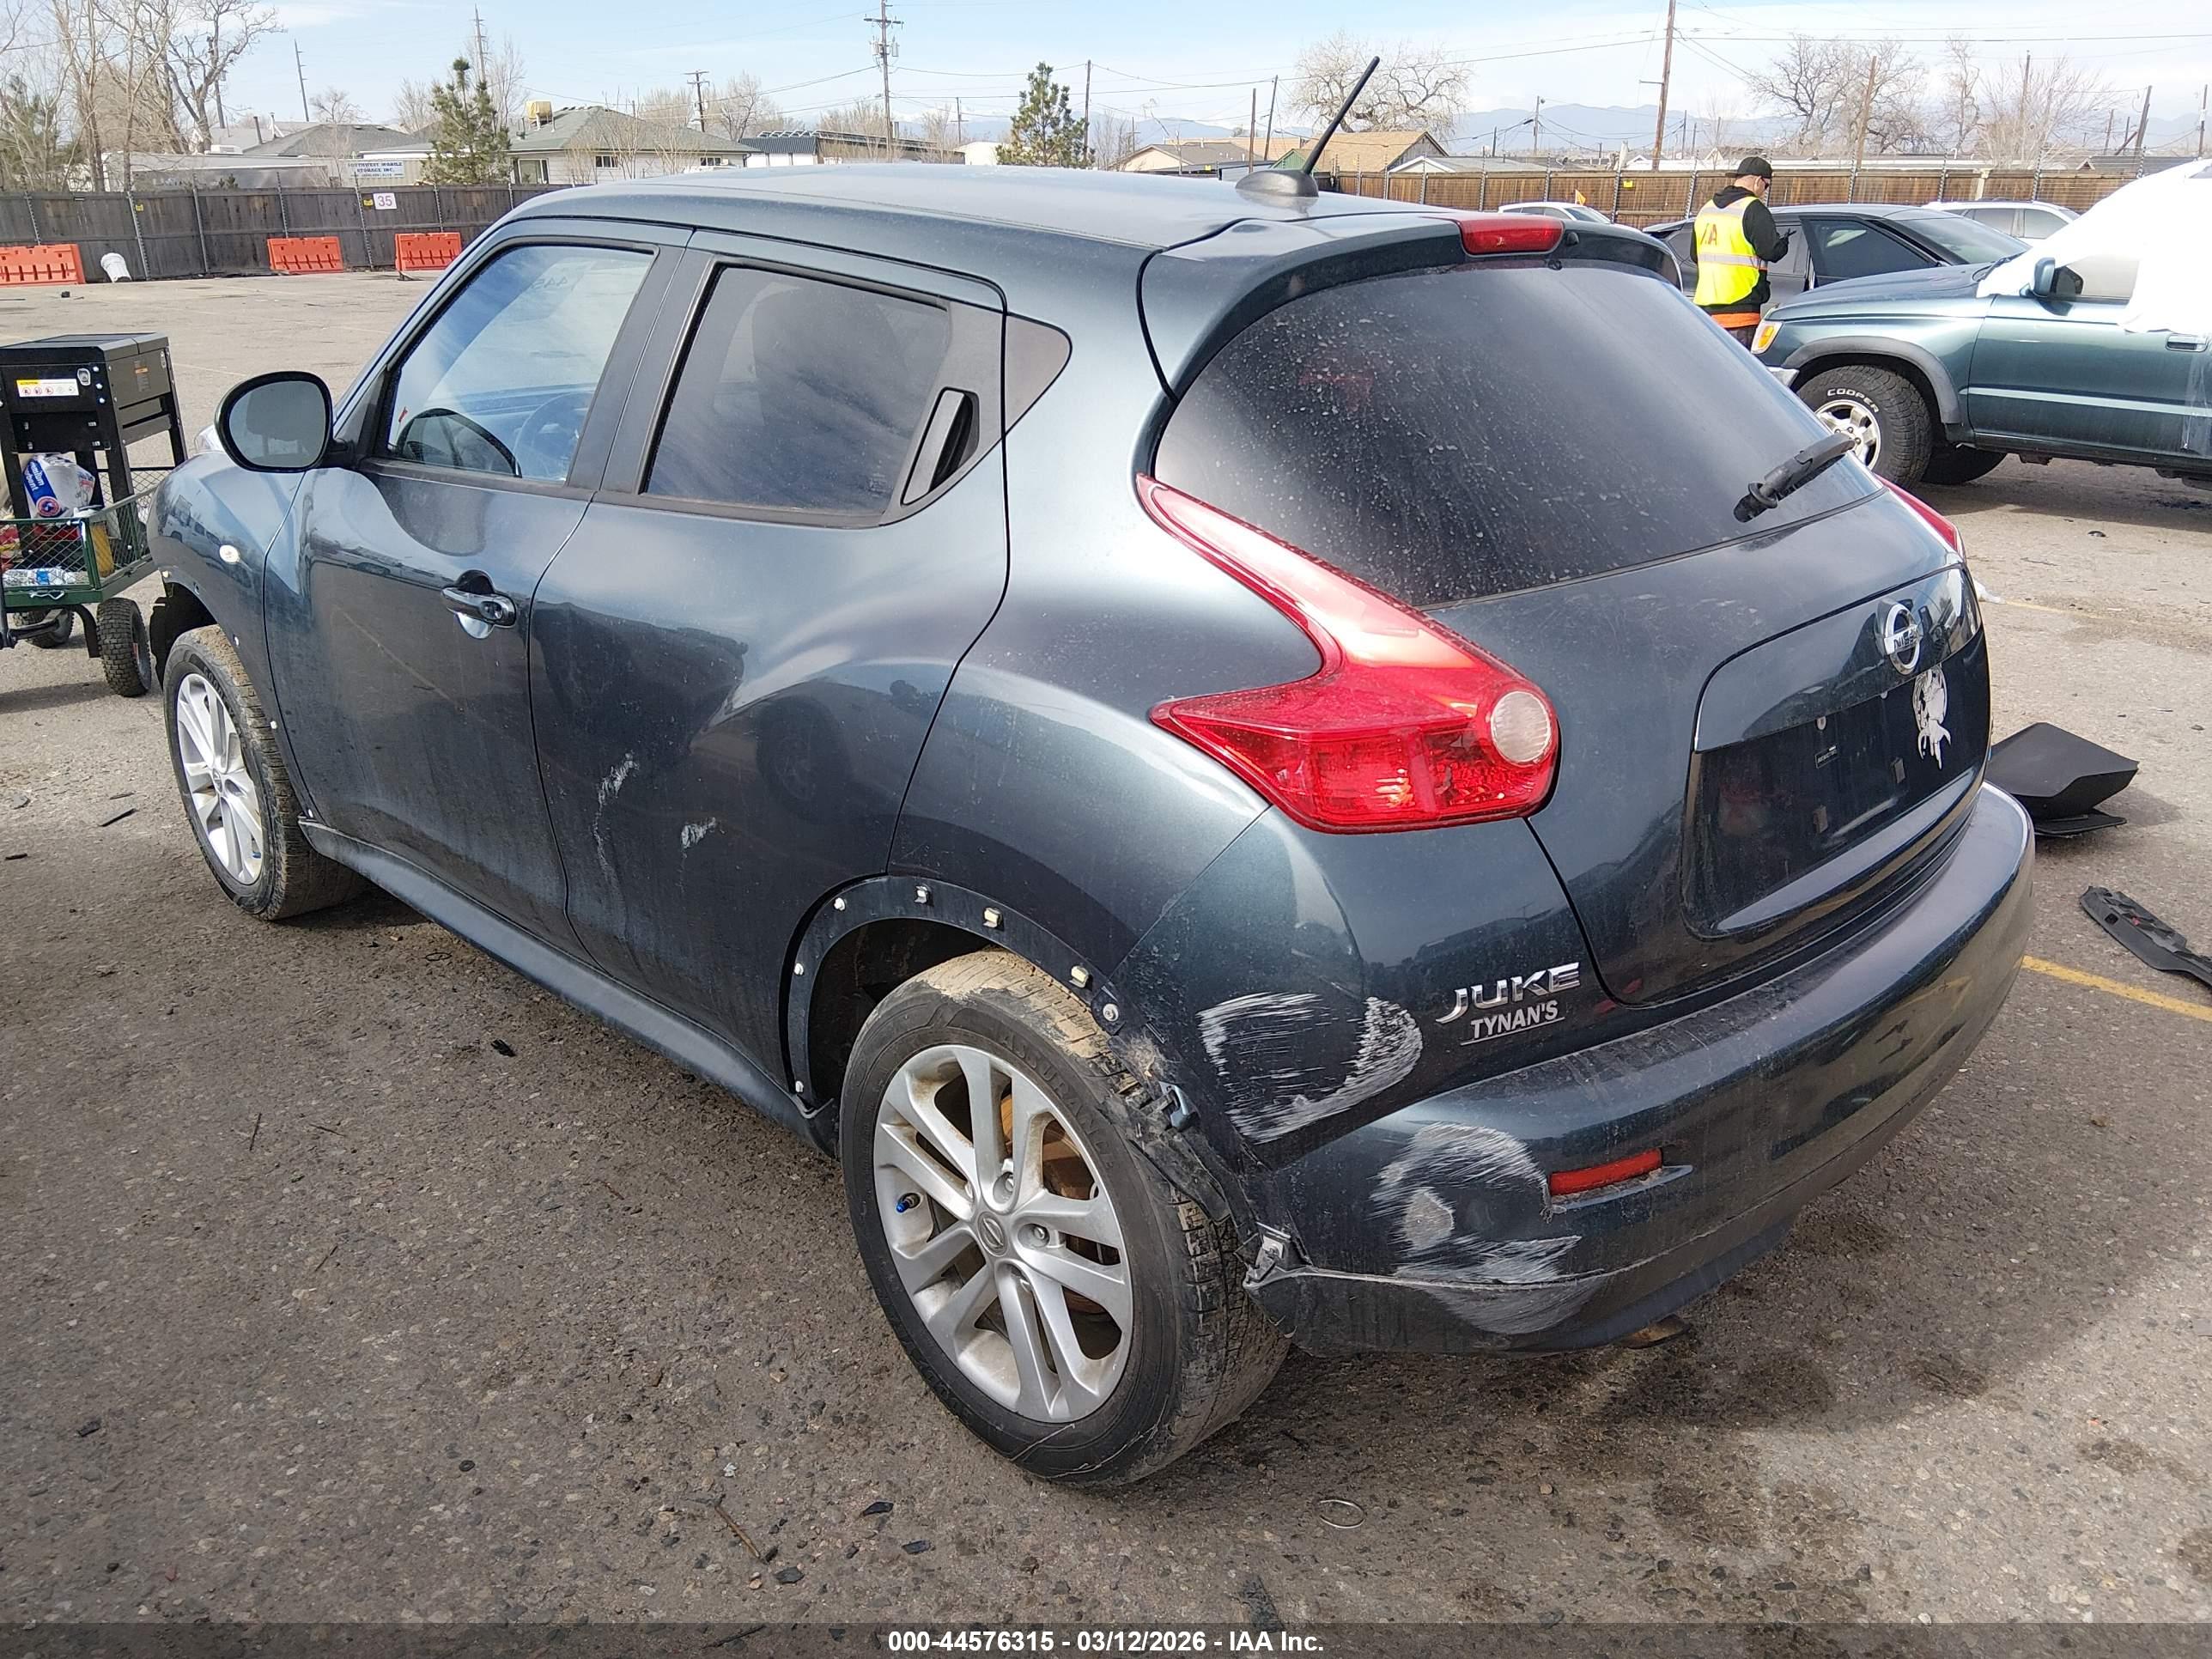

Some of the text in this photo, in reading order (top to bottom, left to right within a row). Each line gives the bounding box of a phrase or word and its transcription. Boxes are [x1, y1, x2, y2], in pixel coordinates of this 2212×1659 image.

[377, 195, 392, 207] 35
[1826, 387, 1880, 413] COOPER
[1435, 961, 1581, 1024] JUKE
[1470, 1000, 1559, 1039] TYNAN'S
